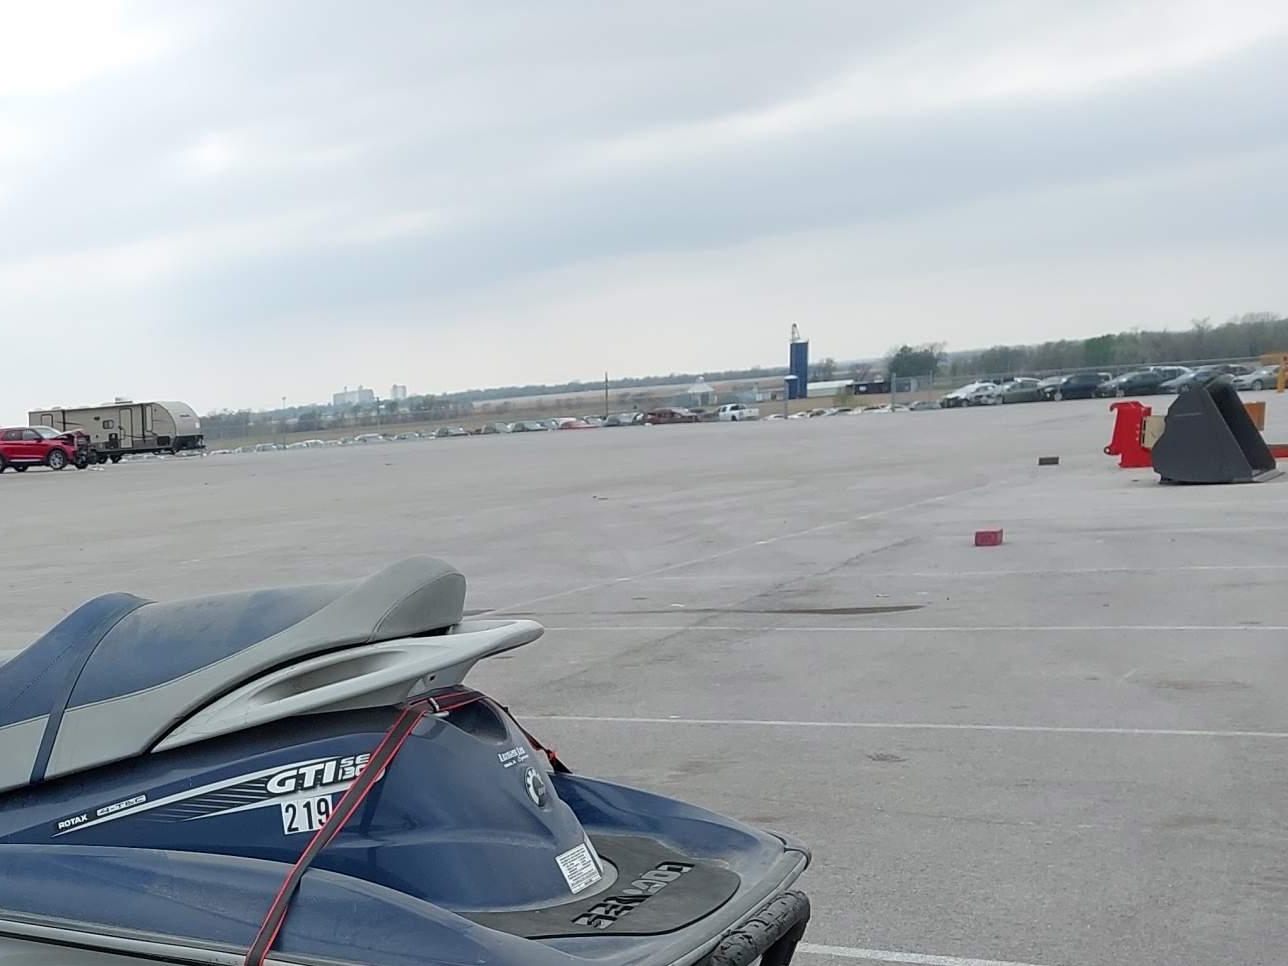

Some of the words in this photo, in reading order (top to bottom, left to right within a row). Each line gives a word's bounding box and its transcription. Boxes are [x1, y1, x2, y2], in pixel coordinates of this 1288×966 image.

[340, 753, 371, 768] SE
[266, 760, 337, 794] GTI
[58, 813, 88, 830] ROTAX
[284, 797, 331, 833] 219
